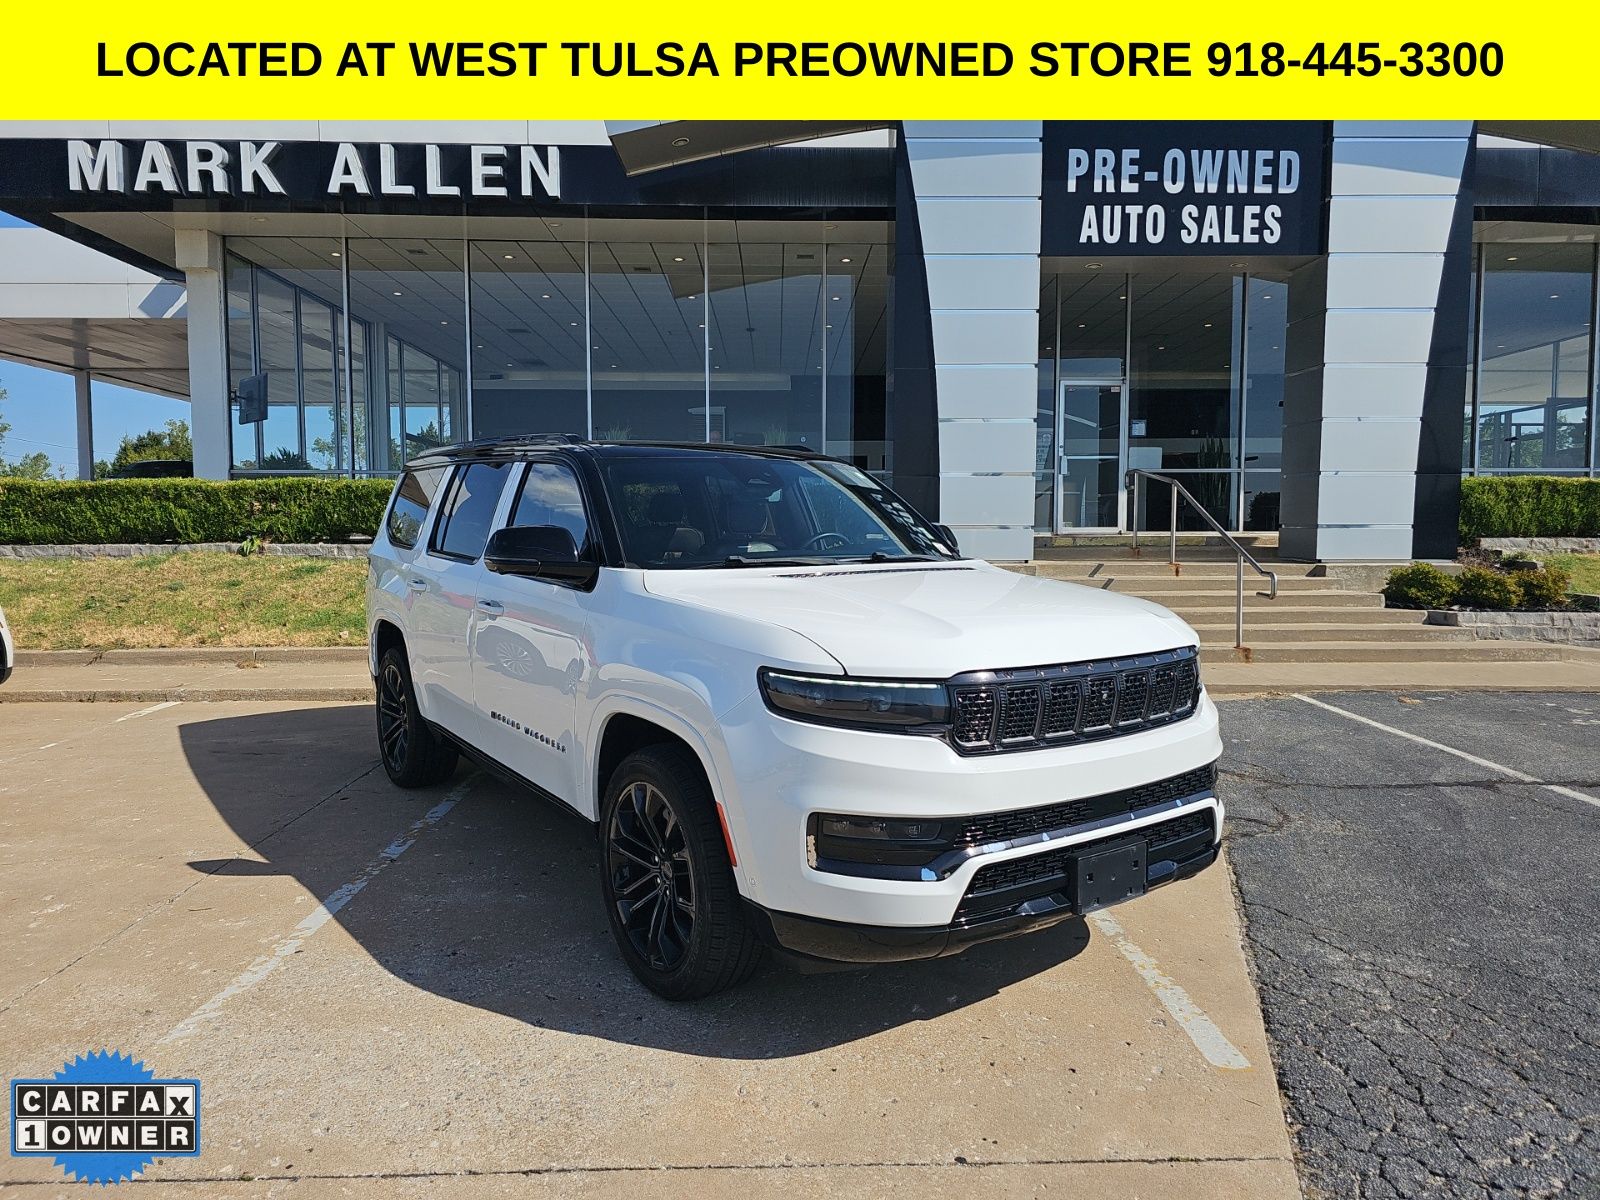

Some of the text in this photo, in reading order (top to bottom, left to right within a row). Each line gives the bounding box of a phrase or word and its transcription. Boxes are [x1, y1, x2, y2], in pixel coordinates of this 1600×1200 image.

[67, 139, 560, 199] MARK ALLEN
[1067, 148, 1300, 194] PRE-OWNED
[1079, 204, 1282, 244] AUTO SALES
